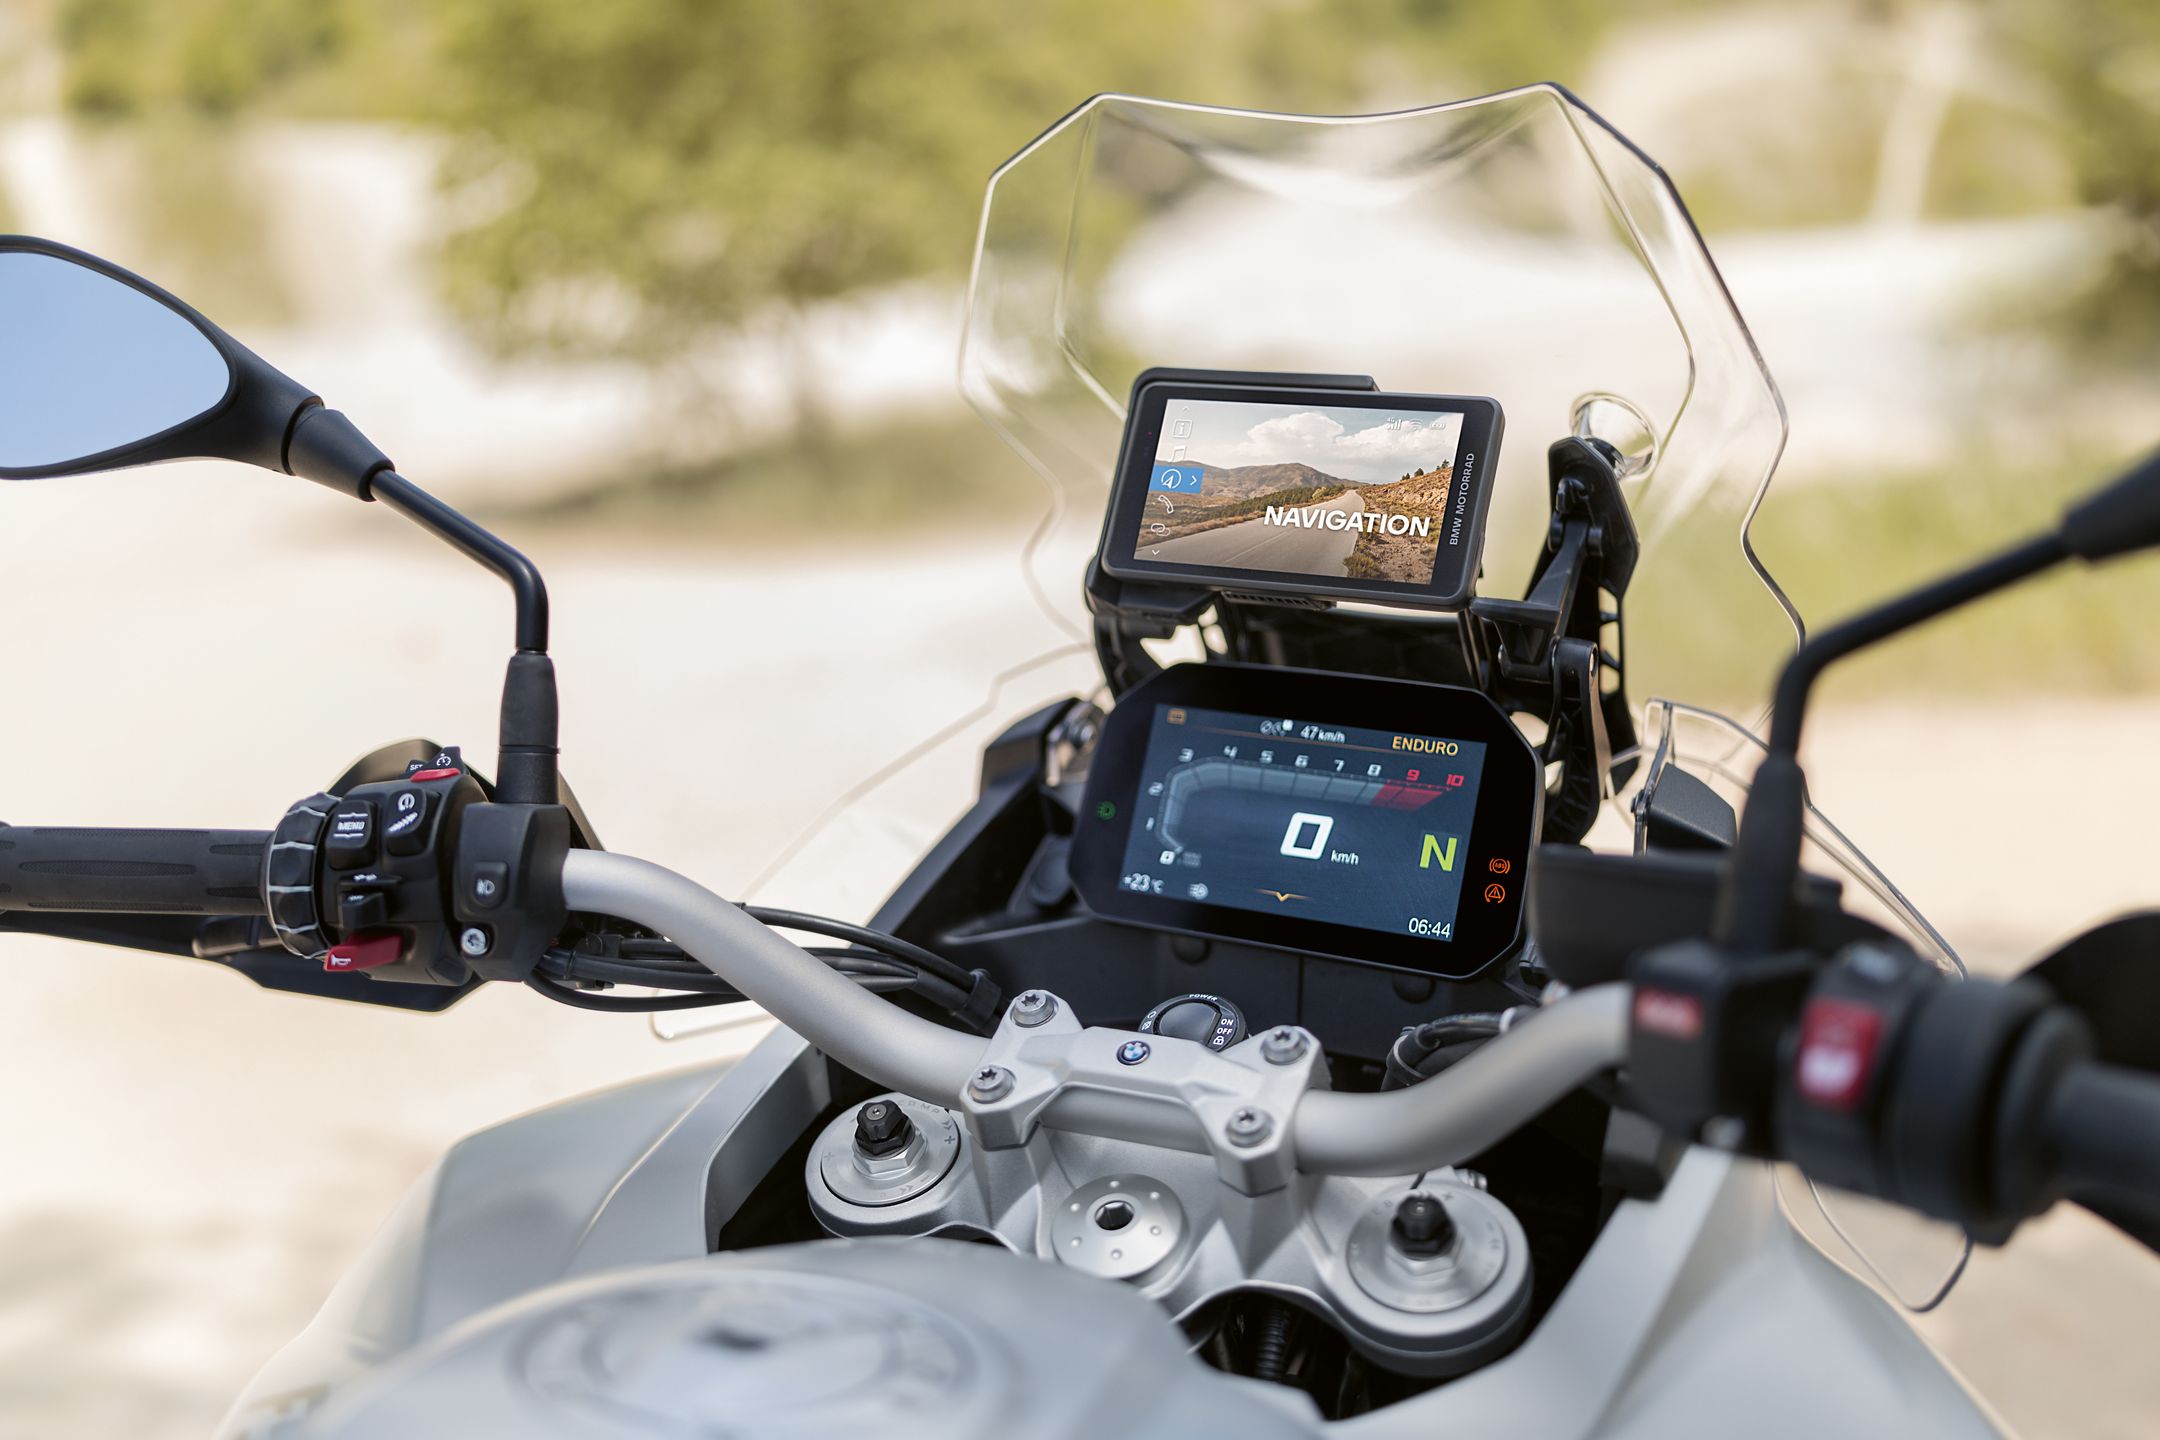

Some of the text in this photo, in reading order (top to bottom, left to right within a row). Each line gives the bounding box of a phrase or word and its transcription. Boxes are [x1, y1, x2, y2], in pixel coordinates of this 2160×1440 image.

[1449, 453, 1475, 545] BMW MOTORRAD
[1263, 505, 1430, 538] NAVIGATION
[1392, 735, 1459, 757] ENDURO
[1178, 745, 1464, 787] 3 4 5 6 7 8 9 10
[1148, 782, 1164, 796] 2
[337, 821, 365, 831] MENU
[1280, 812, 1359, 865] 0 km/h
[1419, 833, 1458, 872] N
[1408, 917, 1451, 938] 06:44
[1188, 993, 1218, 1002] POWER
[1216, 1027, 1233, 1035] OFF
[1220, 1018, 1234, 1026] ON
